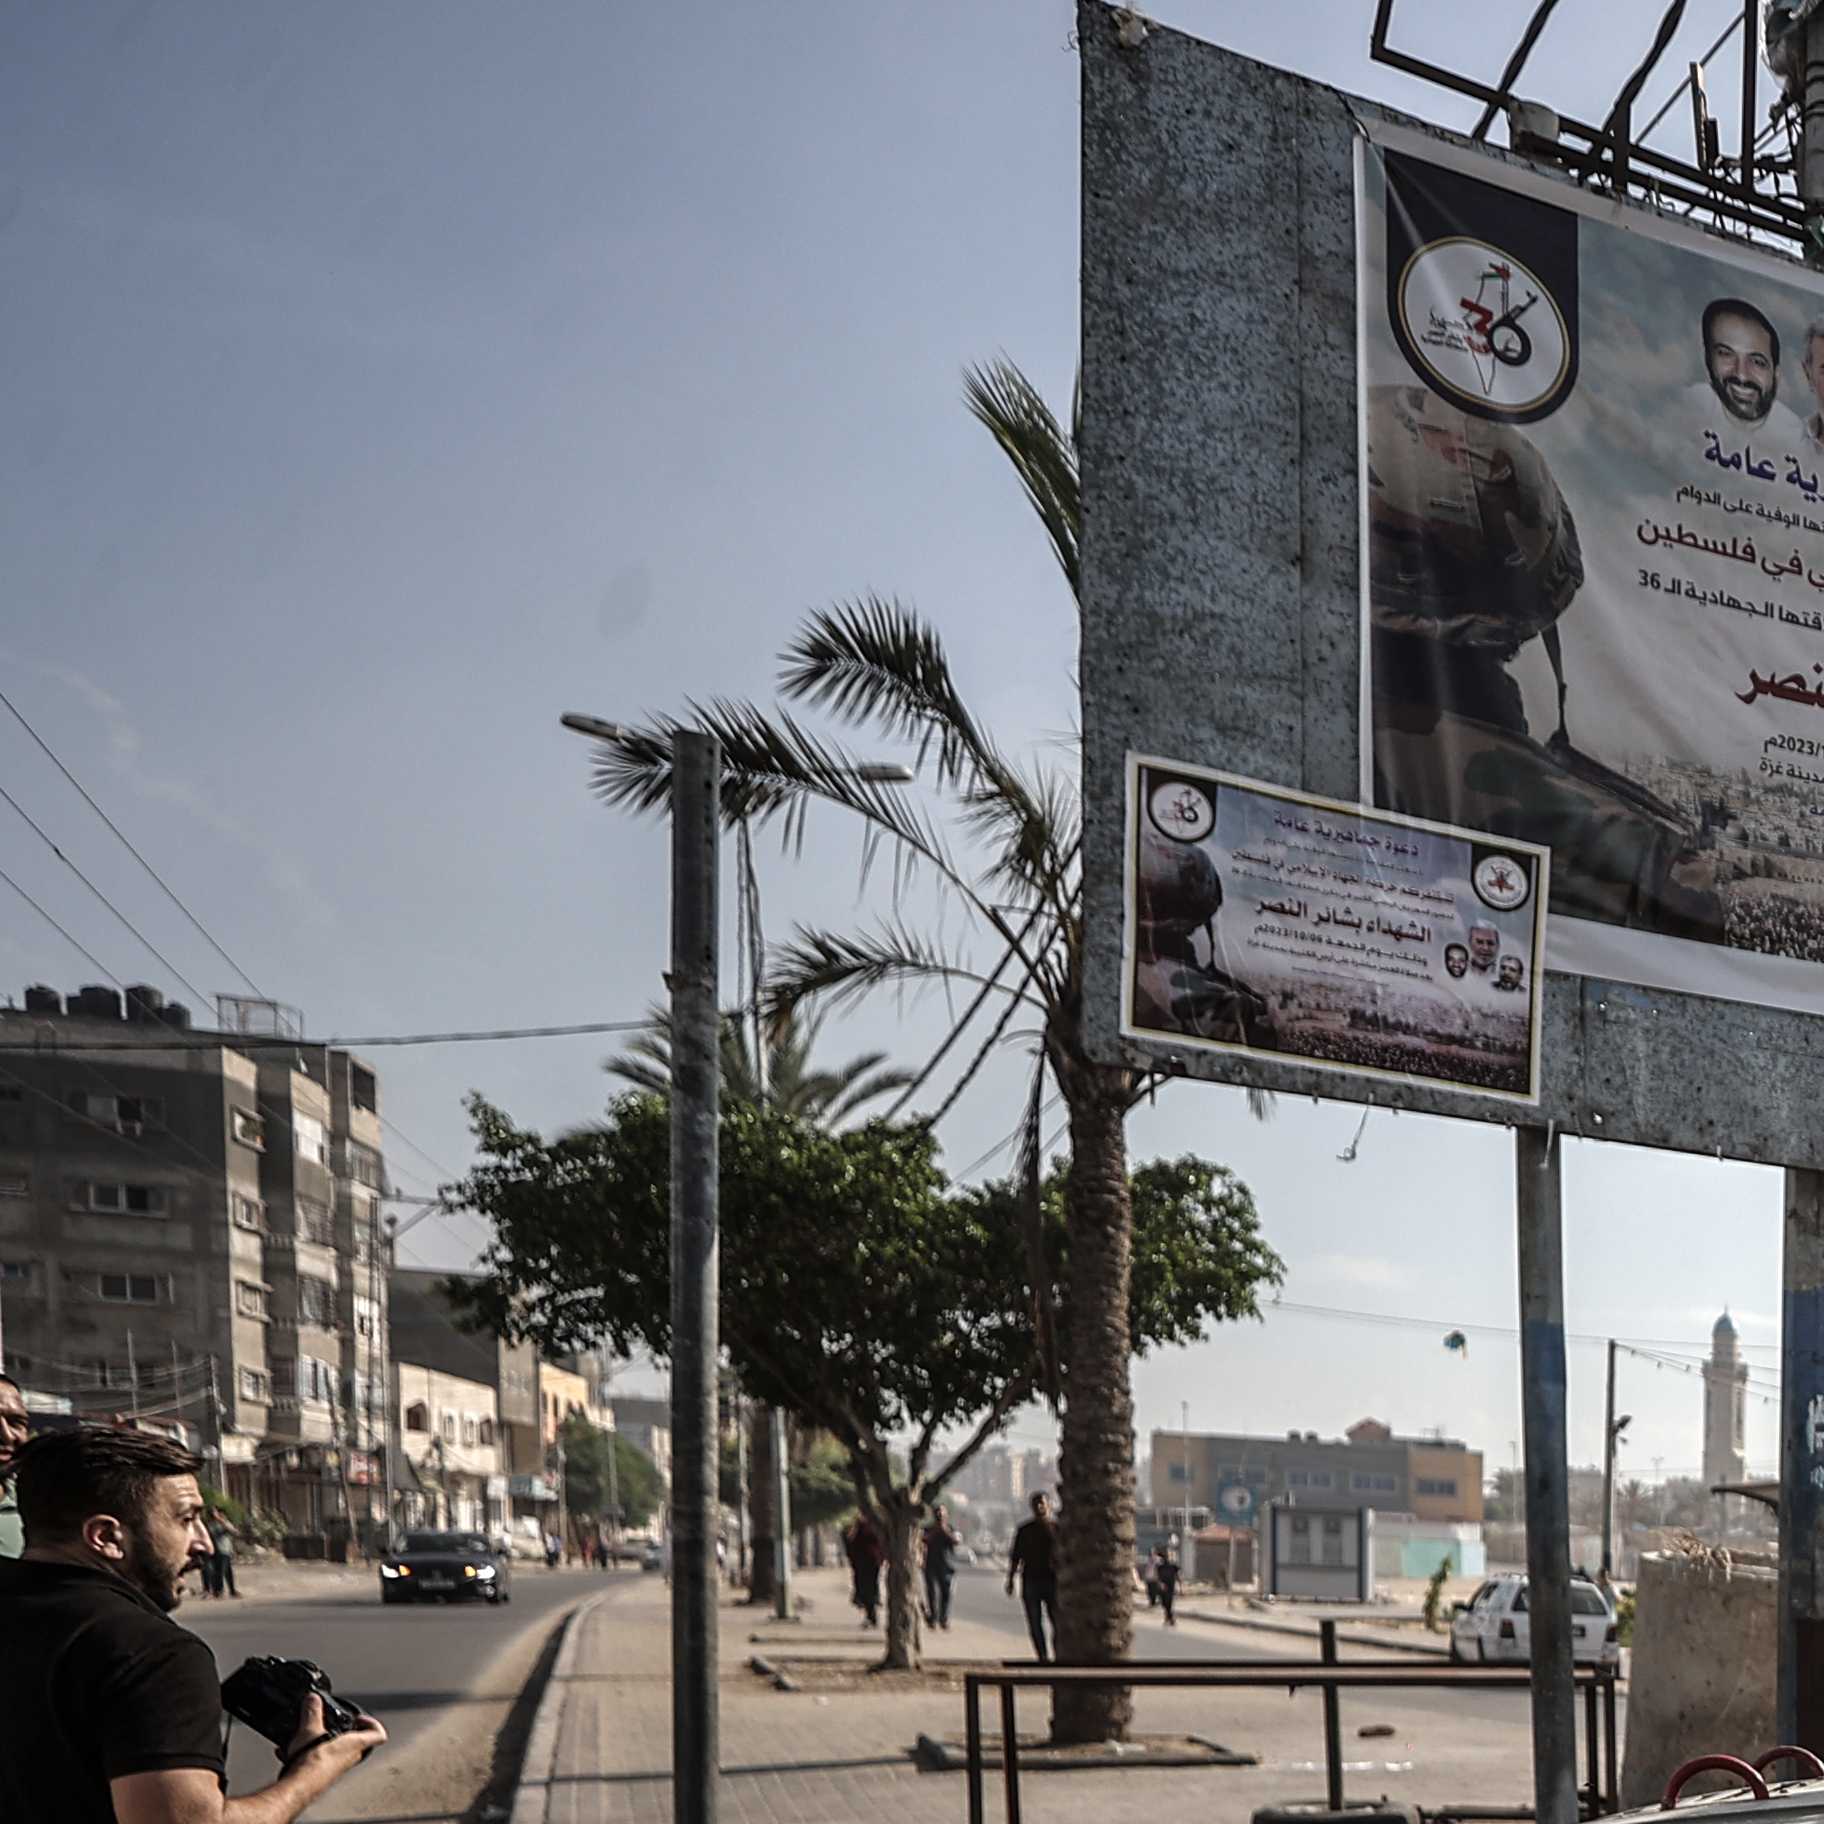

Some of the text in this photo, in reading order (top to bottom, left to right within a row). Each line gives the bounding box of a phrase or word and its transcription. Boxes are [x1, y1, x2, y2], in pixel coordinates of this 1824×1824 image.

[1702, 429, 1777, 482] عامة
[1676, 484, 1722, 509] الدوام
[1722, 496, 1754, 516] على
[1755, 504, 1801, 531] الوفية
[1636, 518, 1757, 564] فلسطين
[1638, 568, 1661, 591] 36
[1760, 548, 1803, 583] في
[1684, 581, 1775, 621] الجهادية
[1759, 756, 1784, 778] غزة
[1255, 896, 1432, 943] الشهداء بشائر النصر
